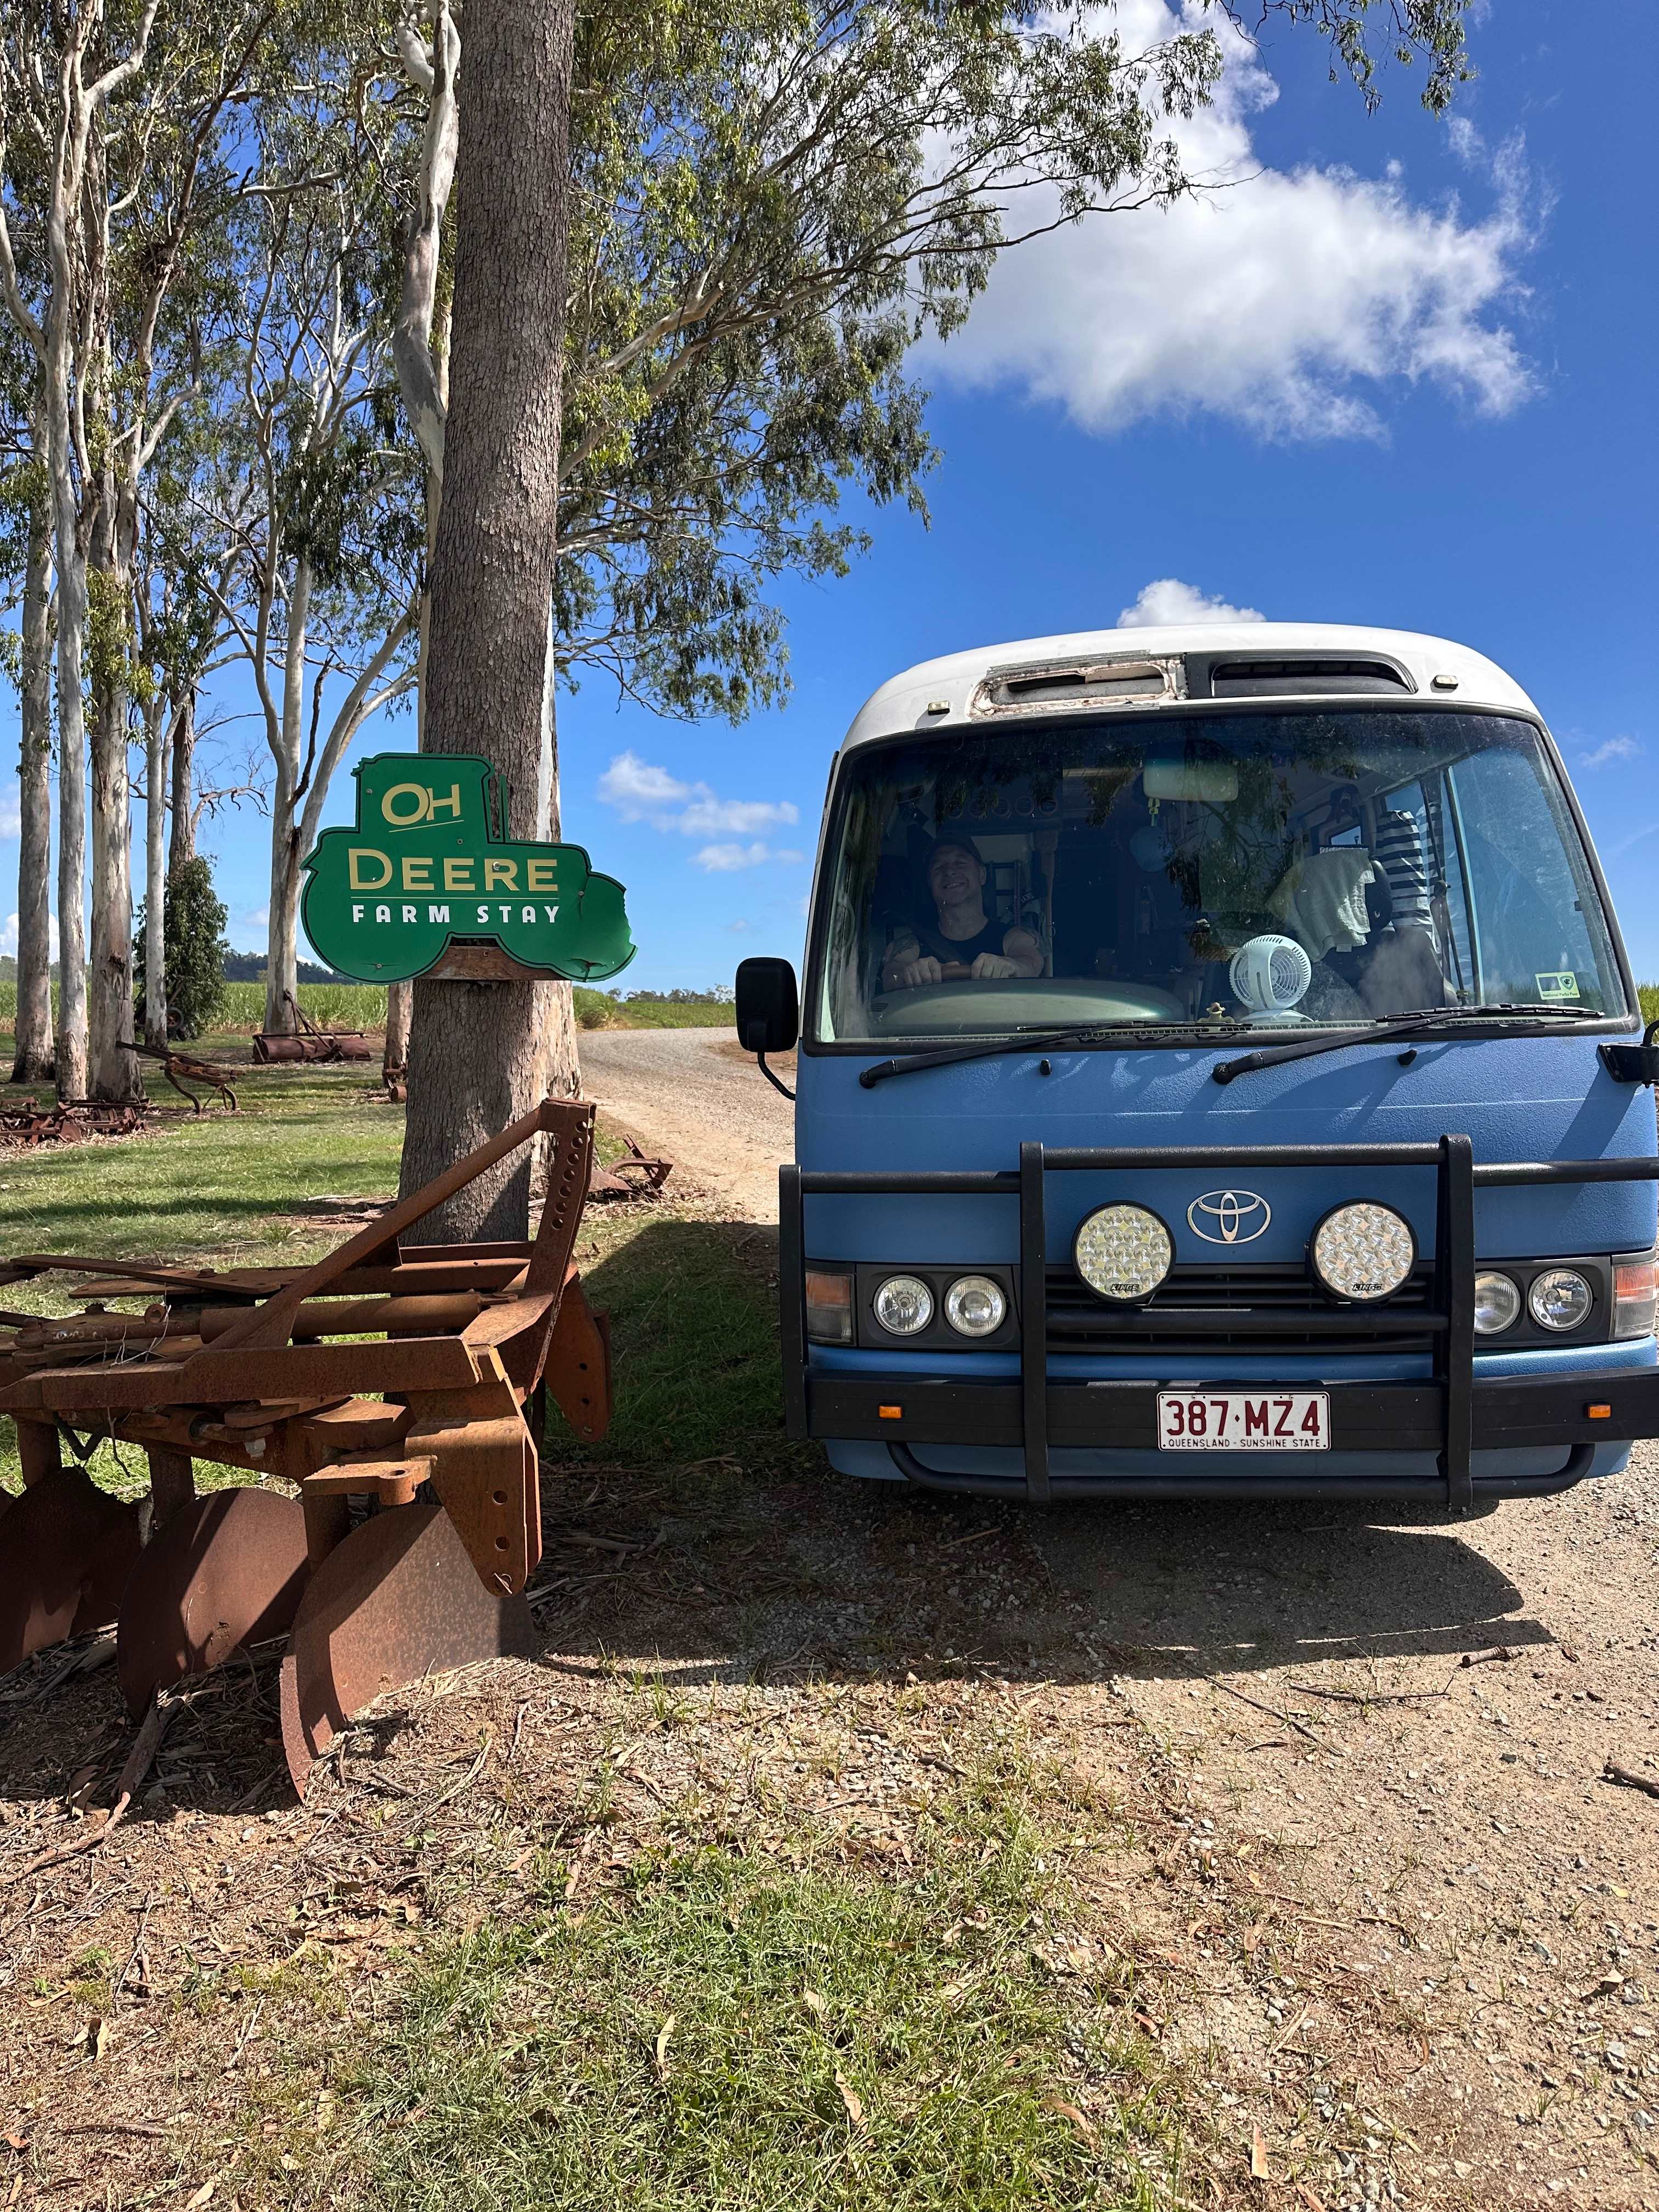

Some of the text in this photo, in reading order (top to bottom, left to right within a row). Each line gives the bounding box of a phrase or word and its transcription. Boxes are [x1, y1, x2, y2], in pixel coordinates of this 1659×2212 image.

[381, 783, 461, 825] OH
[348, 848, 558, 891] DEERE
[352, 905, 560, 923] FARM STAY
[1168, 1438, 1231, 1447] QUEENSLAND
[1240, 1438, 1287, 1447] SUNSHINE
[1293, 1438, 1321, 1447] STATE
